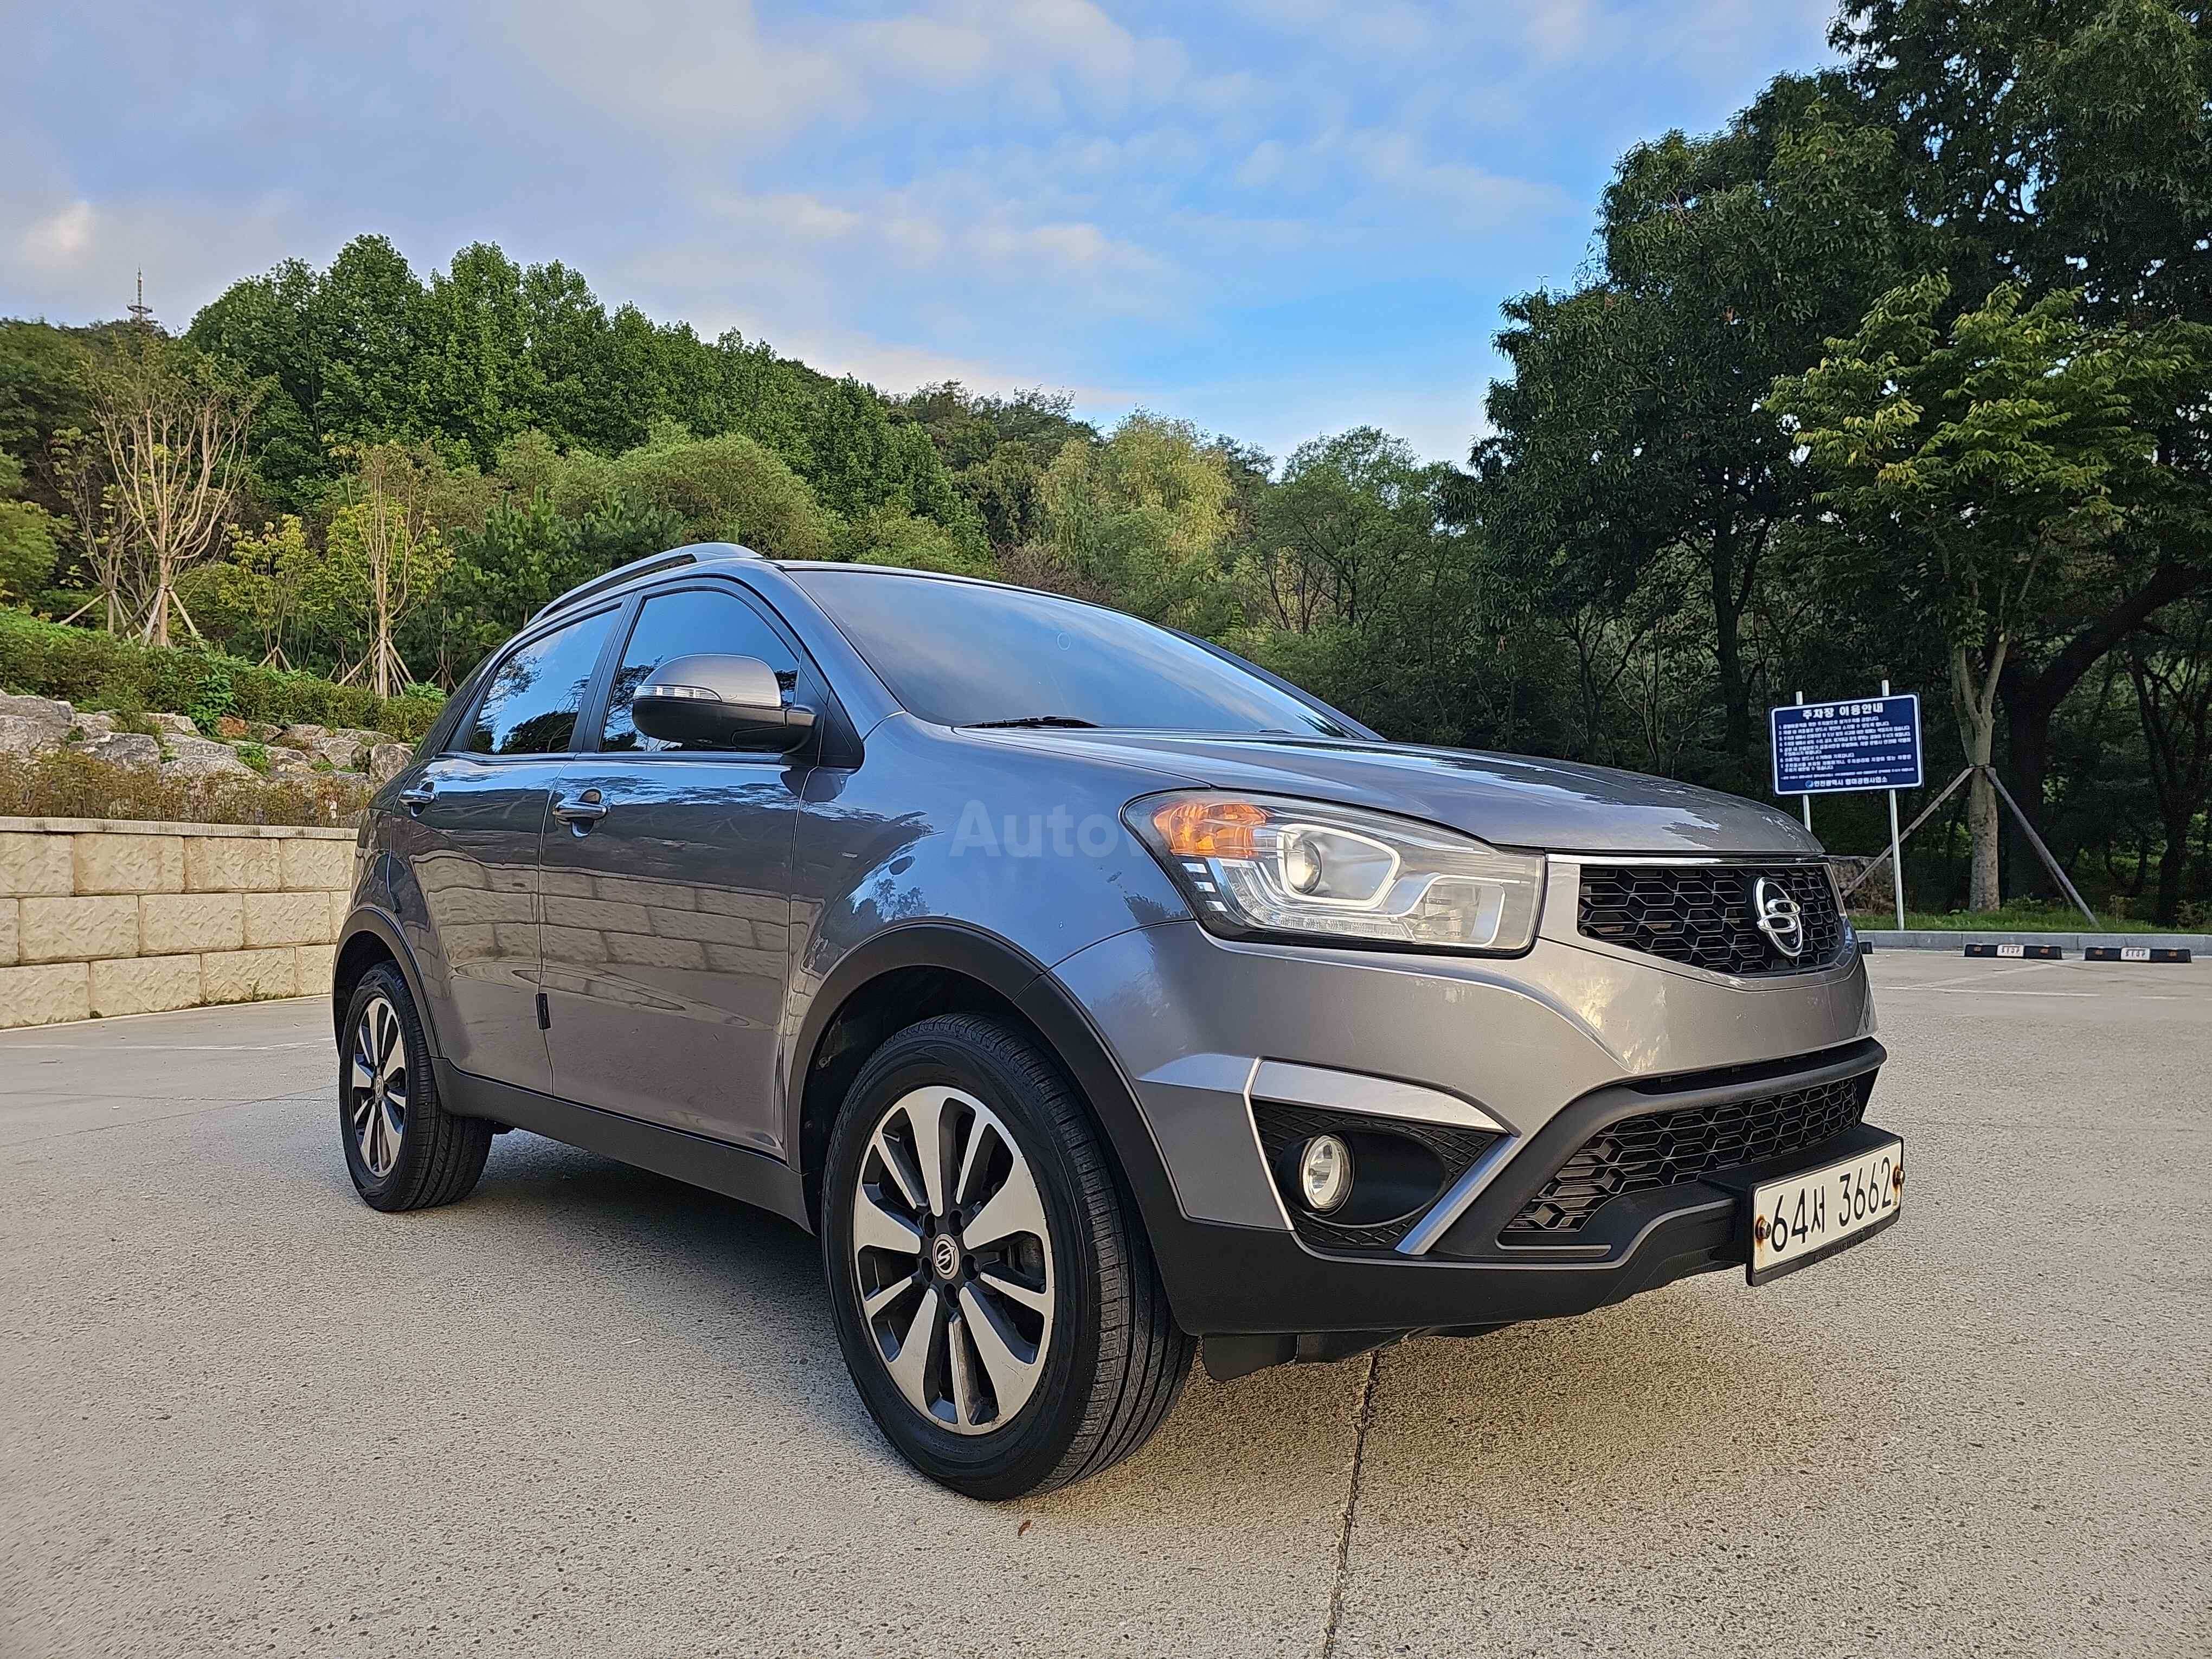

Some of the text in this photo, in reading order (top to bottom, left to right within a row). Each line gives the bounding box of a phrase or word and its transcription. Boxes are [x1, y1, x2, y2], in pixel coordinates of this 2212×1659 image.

[1802, 702, 1883, 720] 주차장 이용안내
[1771, 1184, 1825, 1252] 64서
[1838, 1156, 1892, 1227] 3662
